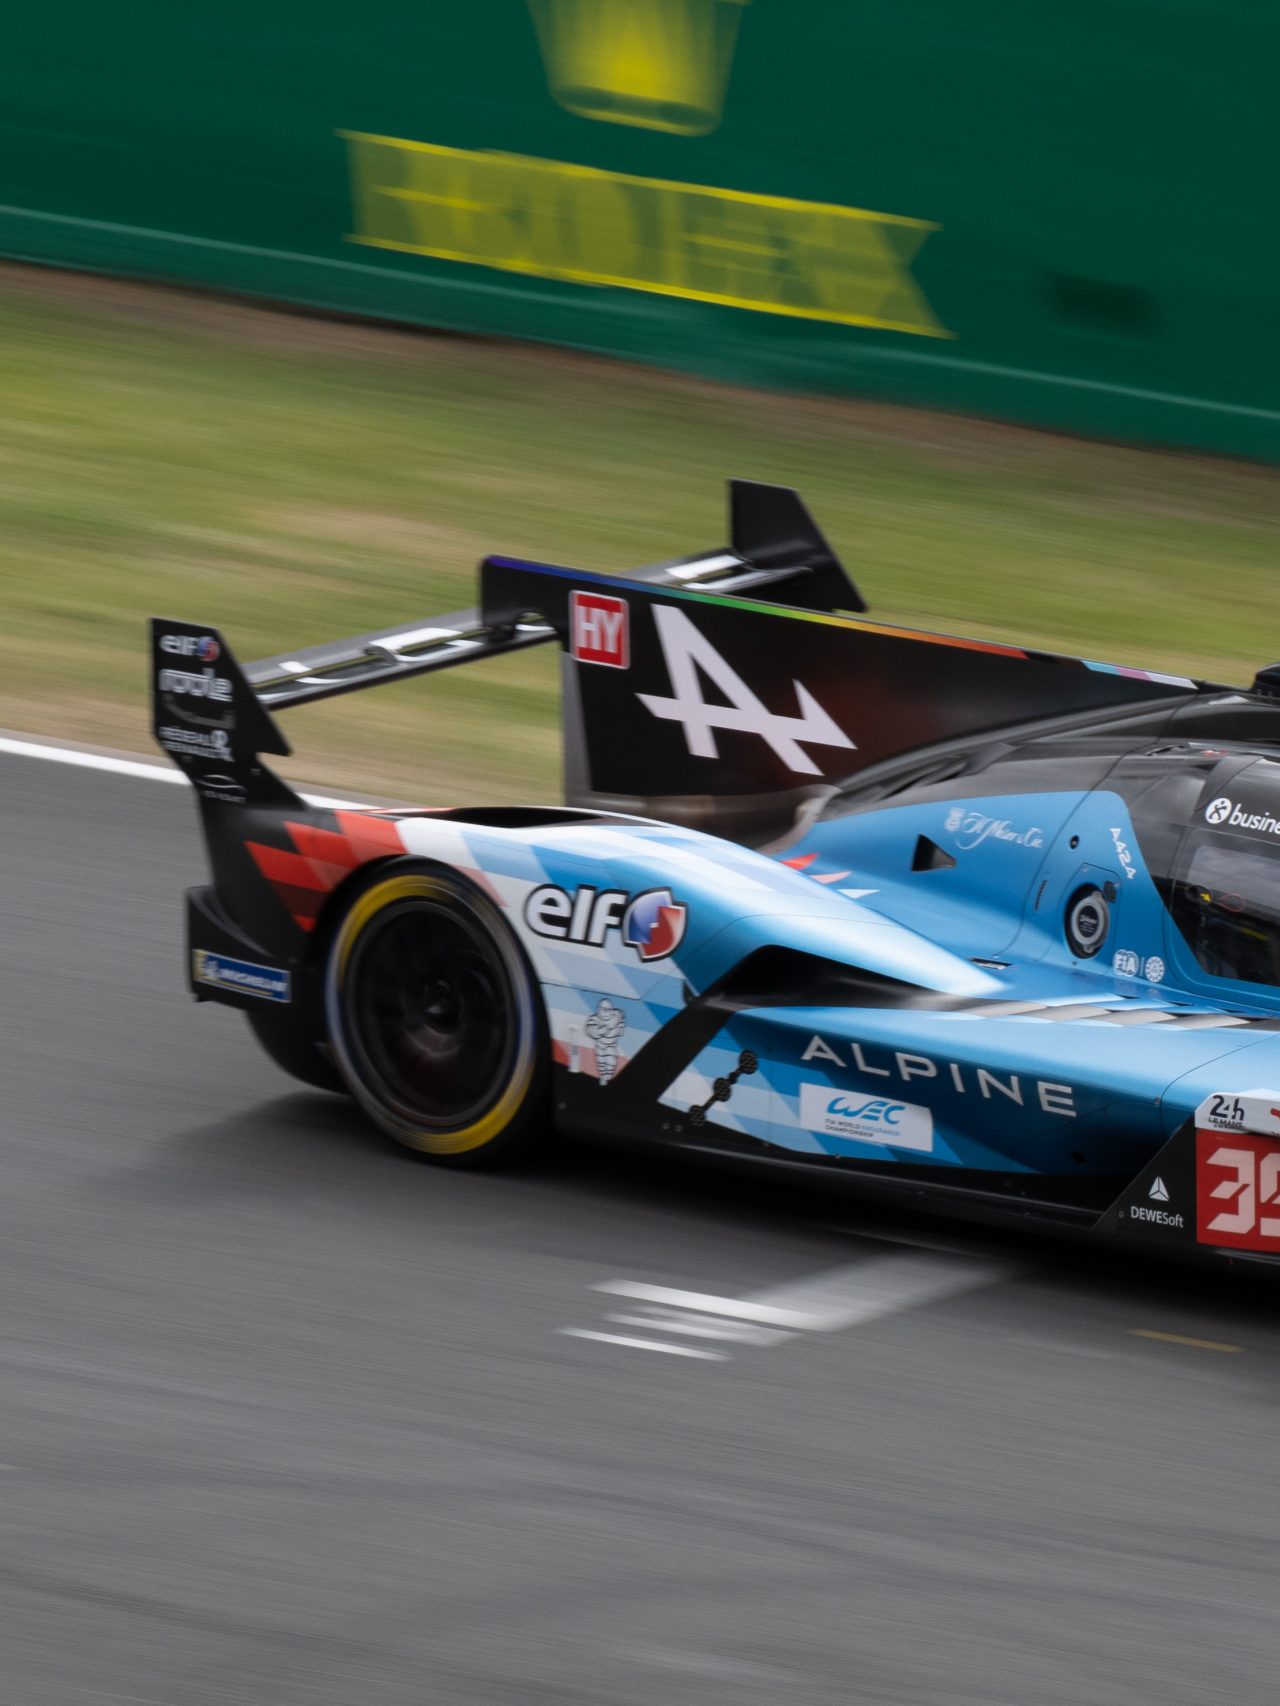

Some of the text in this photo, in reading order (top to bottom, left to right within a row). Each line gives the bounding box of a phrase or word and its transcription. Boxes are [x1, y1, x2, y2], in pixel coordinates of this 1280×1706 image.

[575, 605, 623, 653] HY
[526, 886, 627, 944] elf
[800, 1034, 1077, 1117] ALPINE
[827, 1097, 905, 1124] WEC
[1130, 1206, 1184, 1228] DEWESoft
